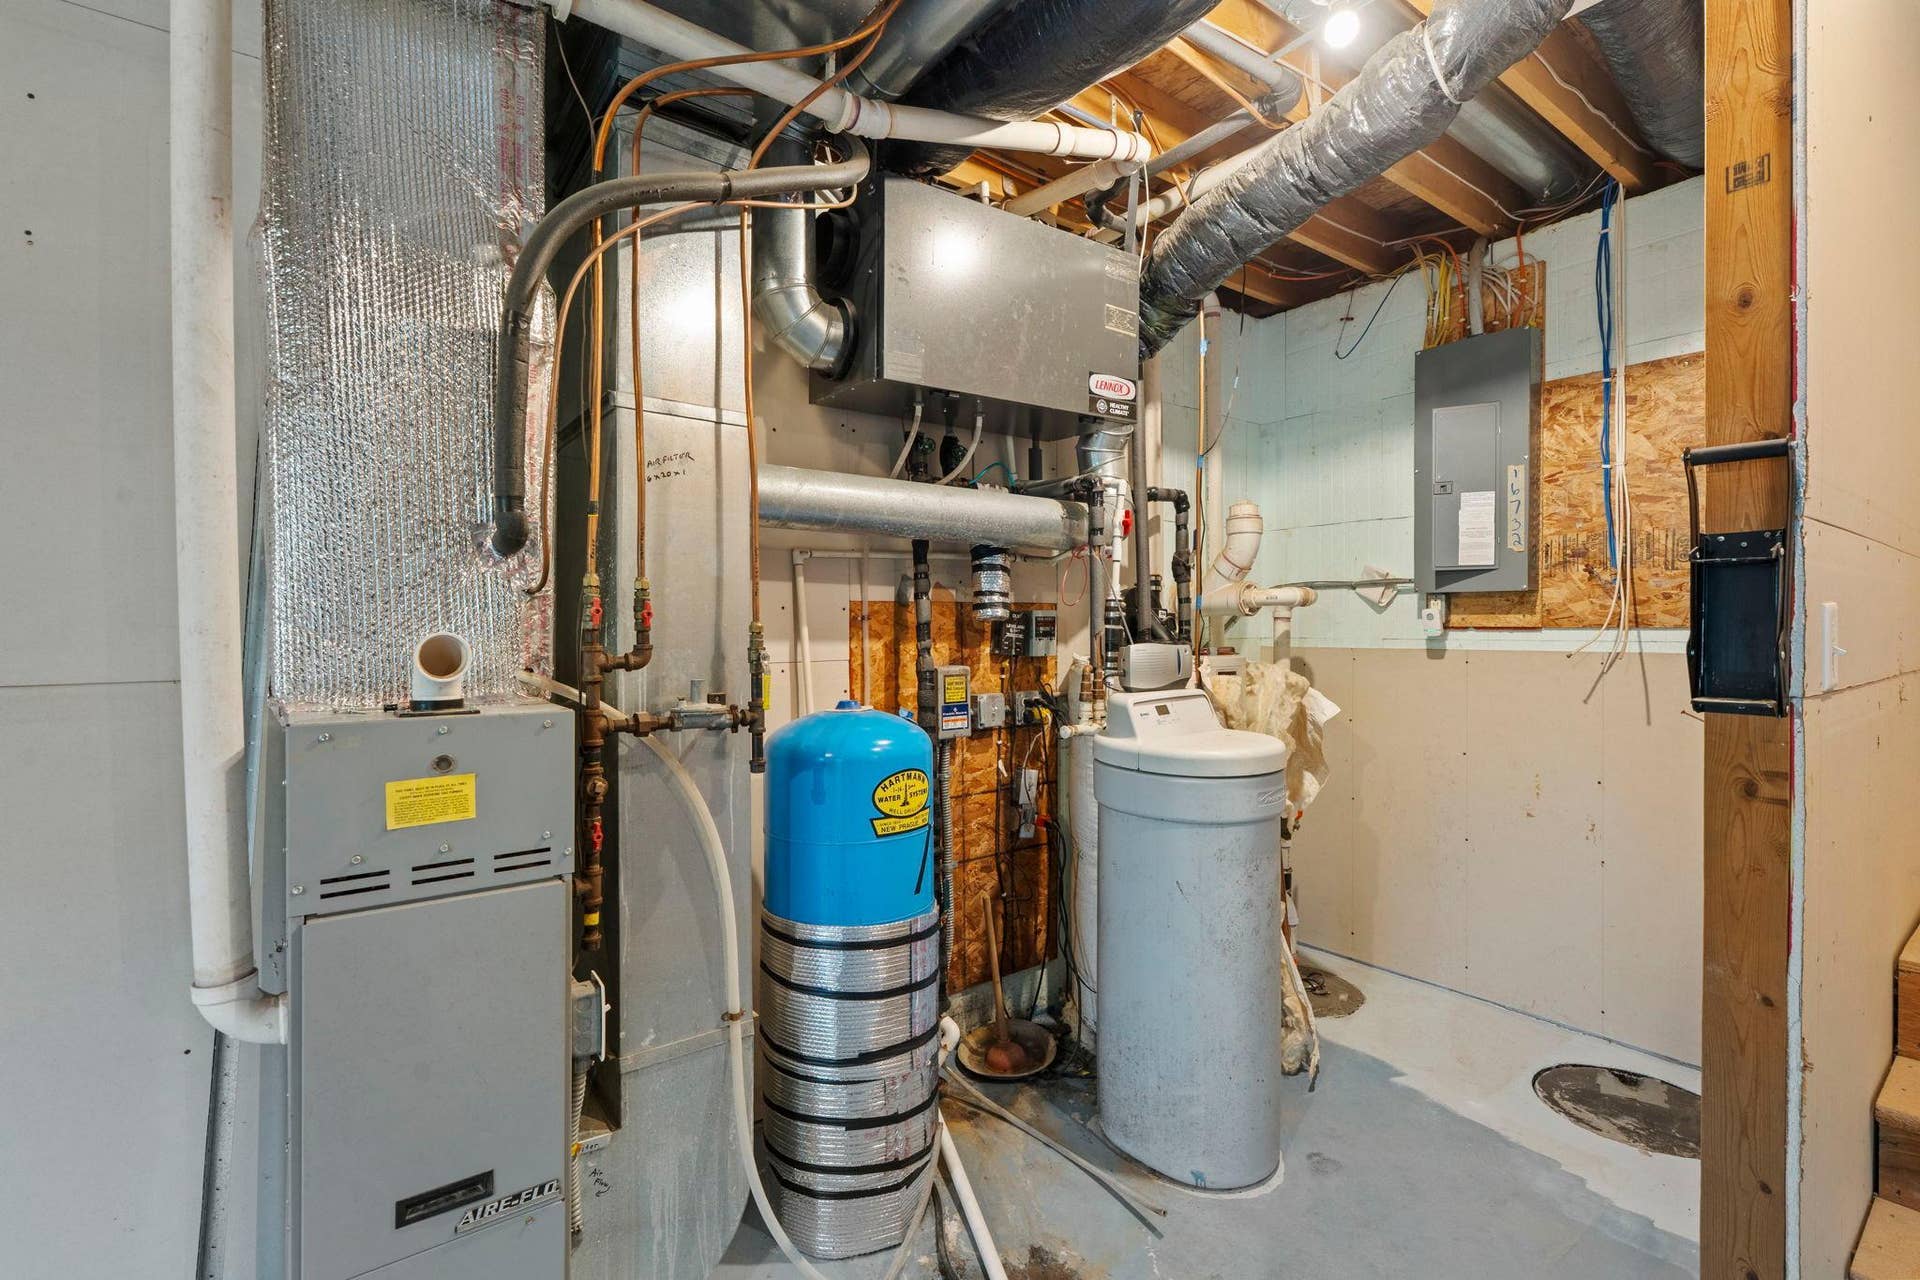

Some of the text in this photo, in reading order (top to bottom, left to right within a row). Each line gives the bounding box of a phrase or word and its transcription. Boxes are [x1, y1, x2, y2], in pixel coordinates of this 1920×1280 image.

[1095, 380, 1123, 393] LENNOX
[1110, 402, 1129, 410] HEALTHY
[646, 458, 662, 469] AIR
[881, 773, 925, 792] HARTMANN
[878, 795, 901, 803] WATER
[460, 1179, 560, 1226] AIRE-FLO
